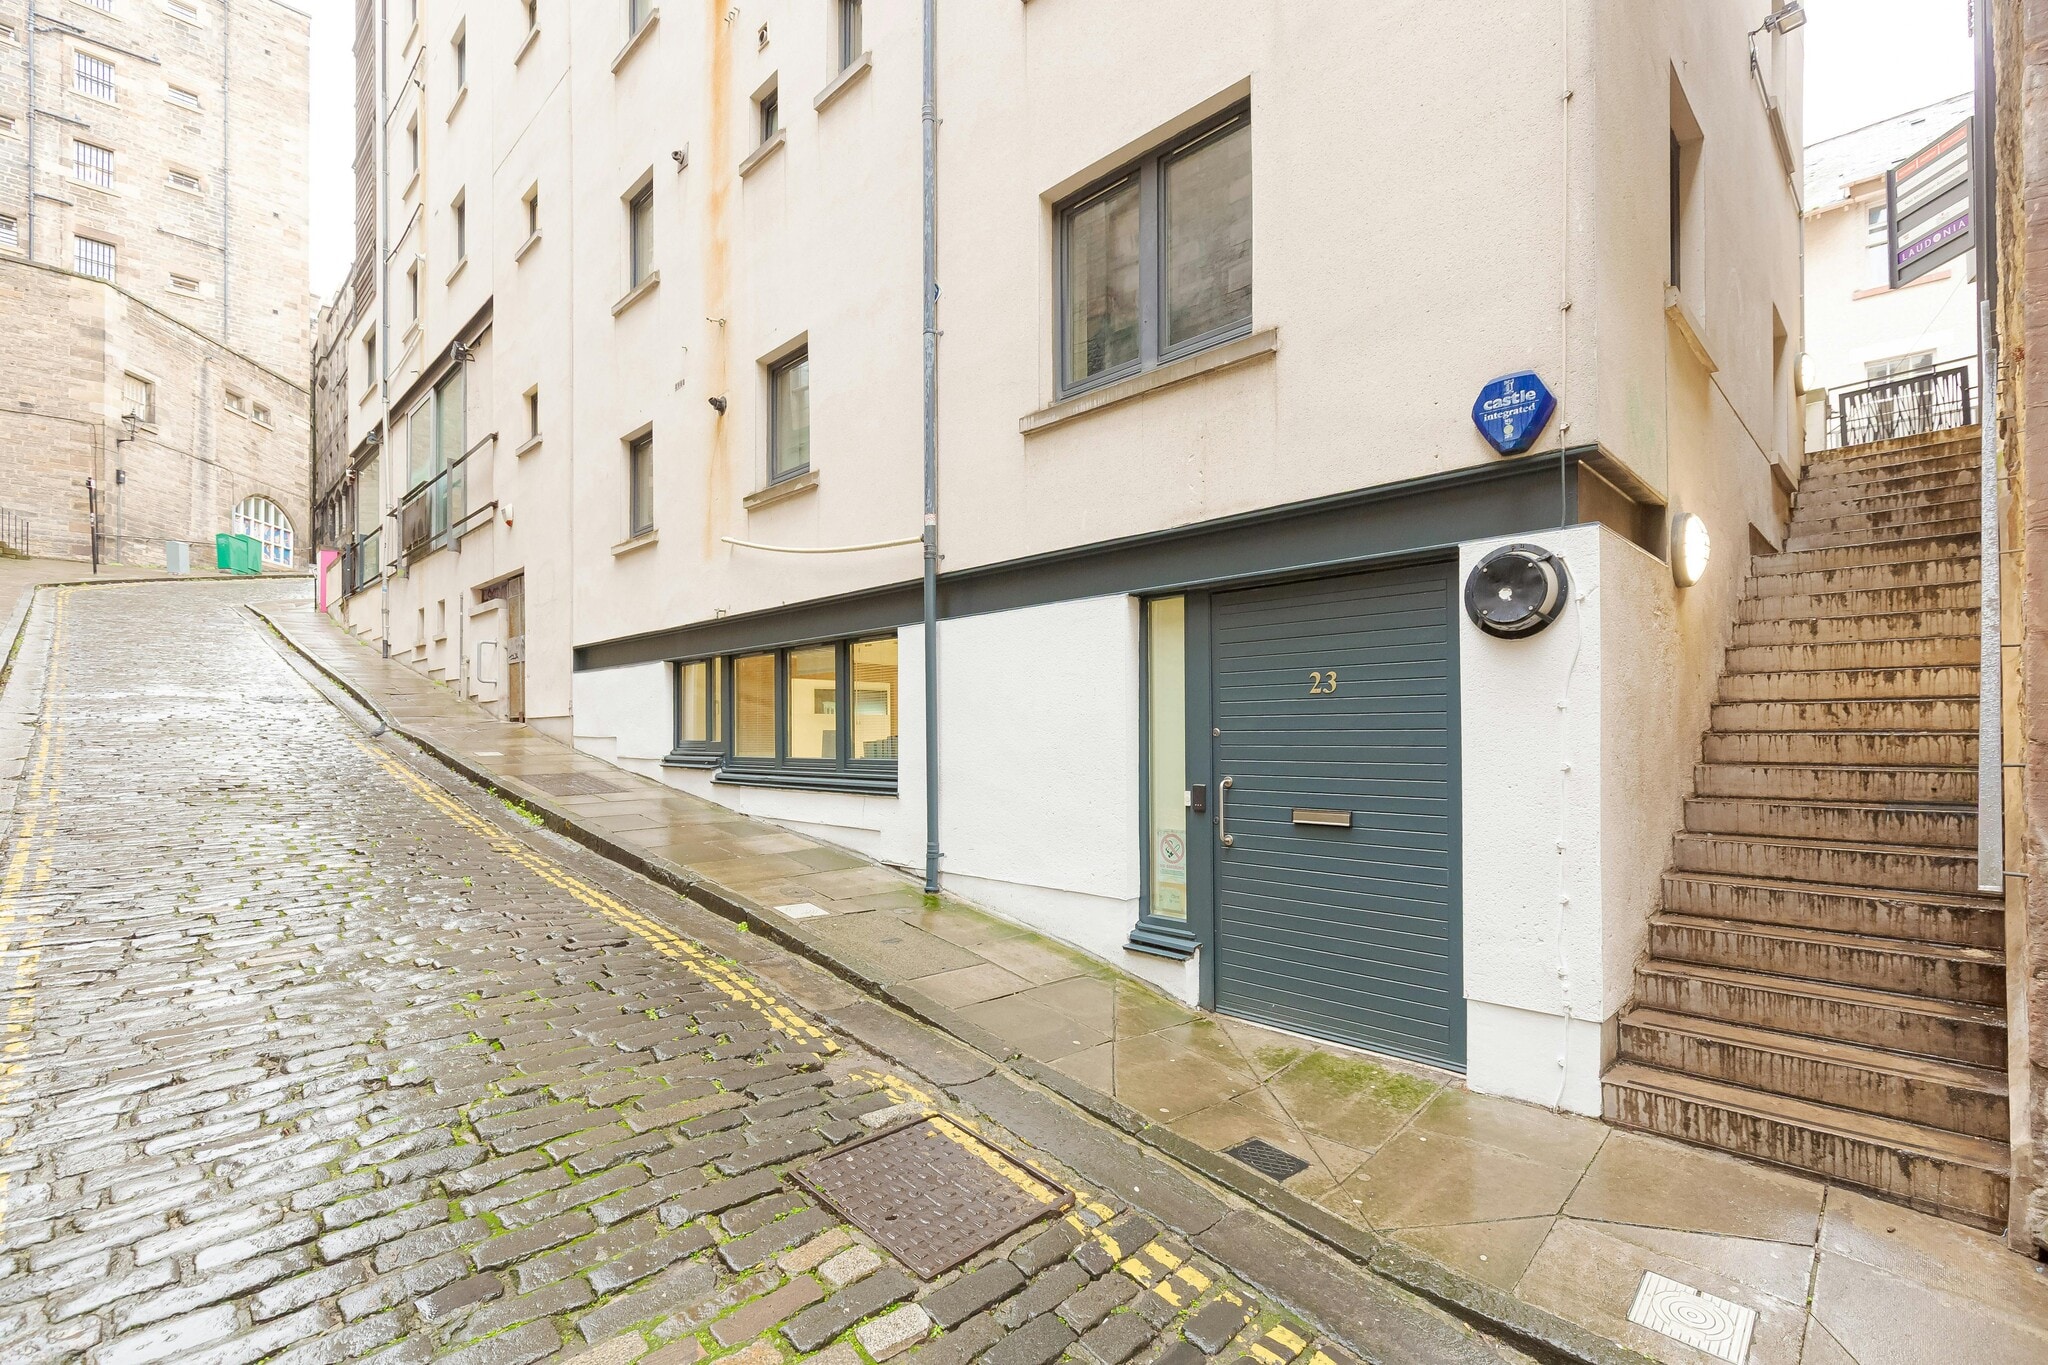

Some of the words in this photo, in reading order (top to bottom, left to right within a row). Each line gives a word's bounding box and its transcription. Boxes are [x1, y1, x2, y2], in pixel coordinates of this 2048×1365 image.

[1901, 219, 1967, 262] LAUDONIA
[1483, 389, 1537, 411] castle
[1483, 402, 1536, 422] integrated
[1309, 671, 1338, 695] 23
